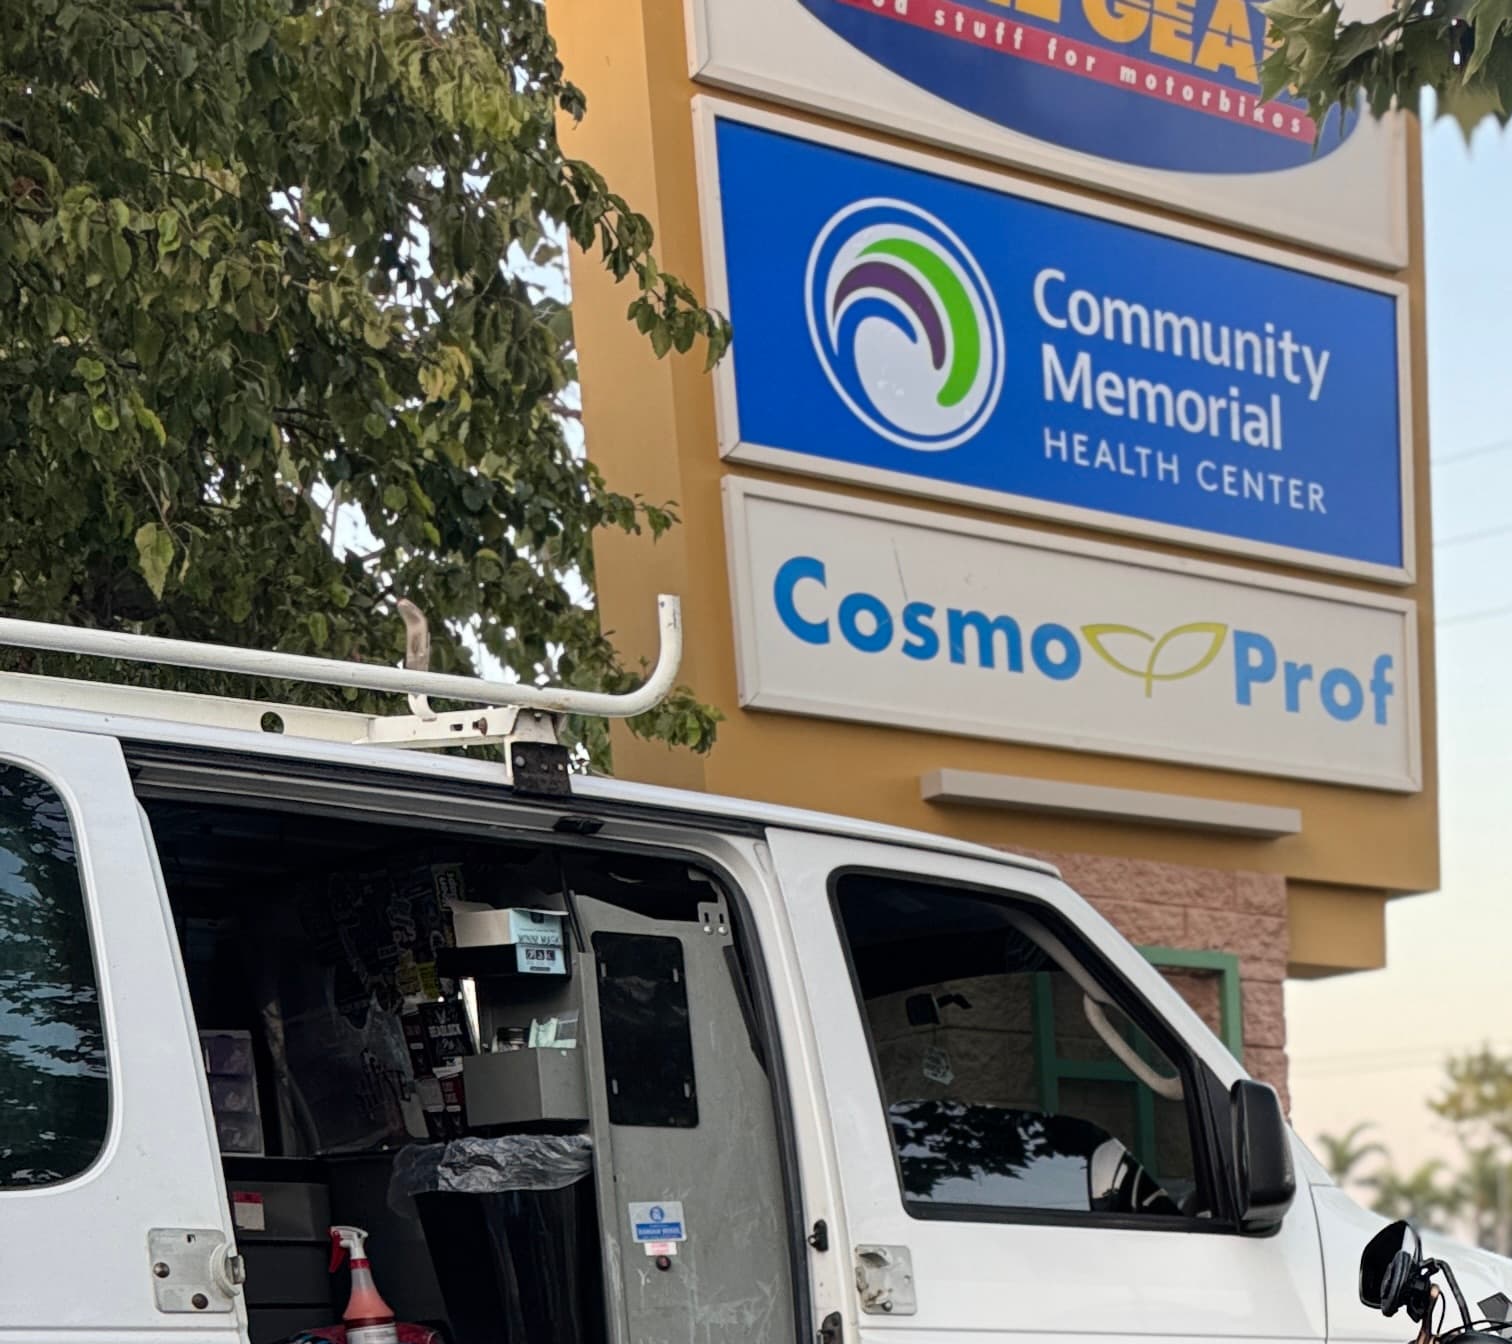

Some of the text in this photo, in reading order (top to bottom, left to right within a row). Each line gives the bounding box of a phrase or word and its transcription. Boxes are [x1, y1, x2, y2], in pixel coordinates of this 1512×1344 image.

[934, 9, 1024, 50] stuff
[1047, 38, 1096, 72] for
[1119, 65, 1301, 134] motorbikes
[1082, 0, 1300, 95] GEA
[1032, 267, 1330, 401] Community
[1042, 342, 1283, 450] Memorial
[1044, 427, 1328, 515] HEALTH CENTER
[772, 556, 1395, 727] Cosmo Prof
